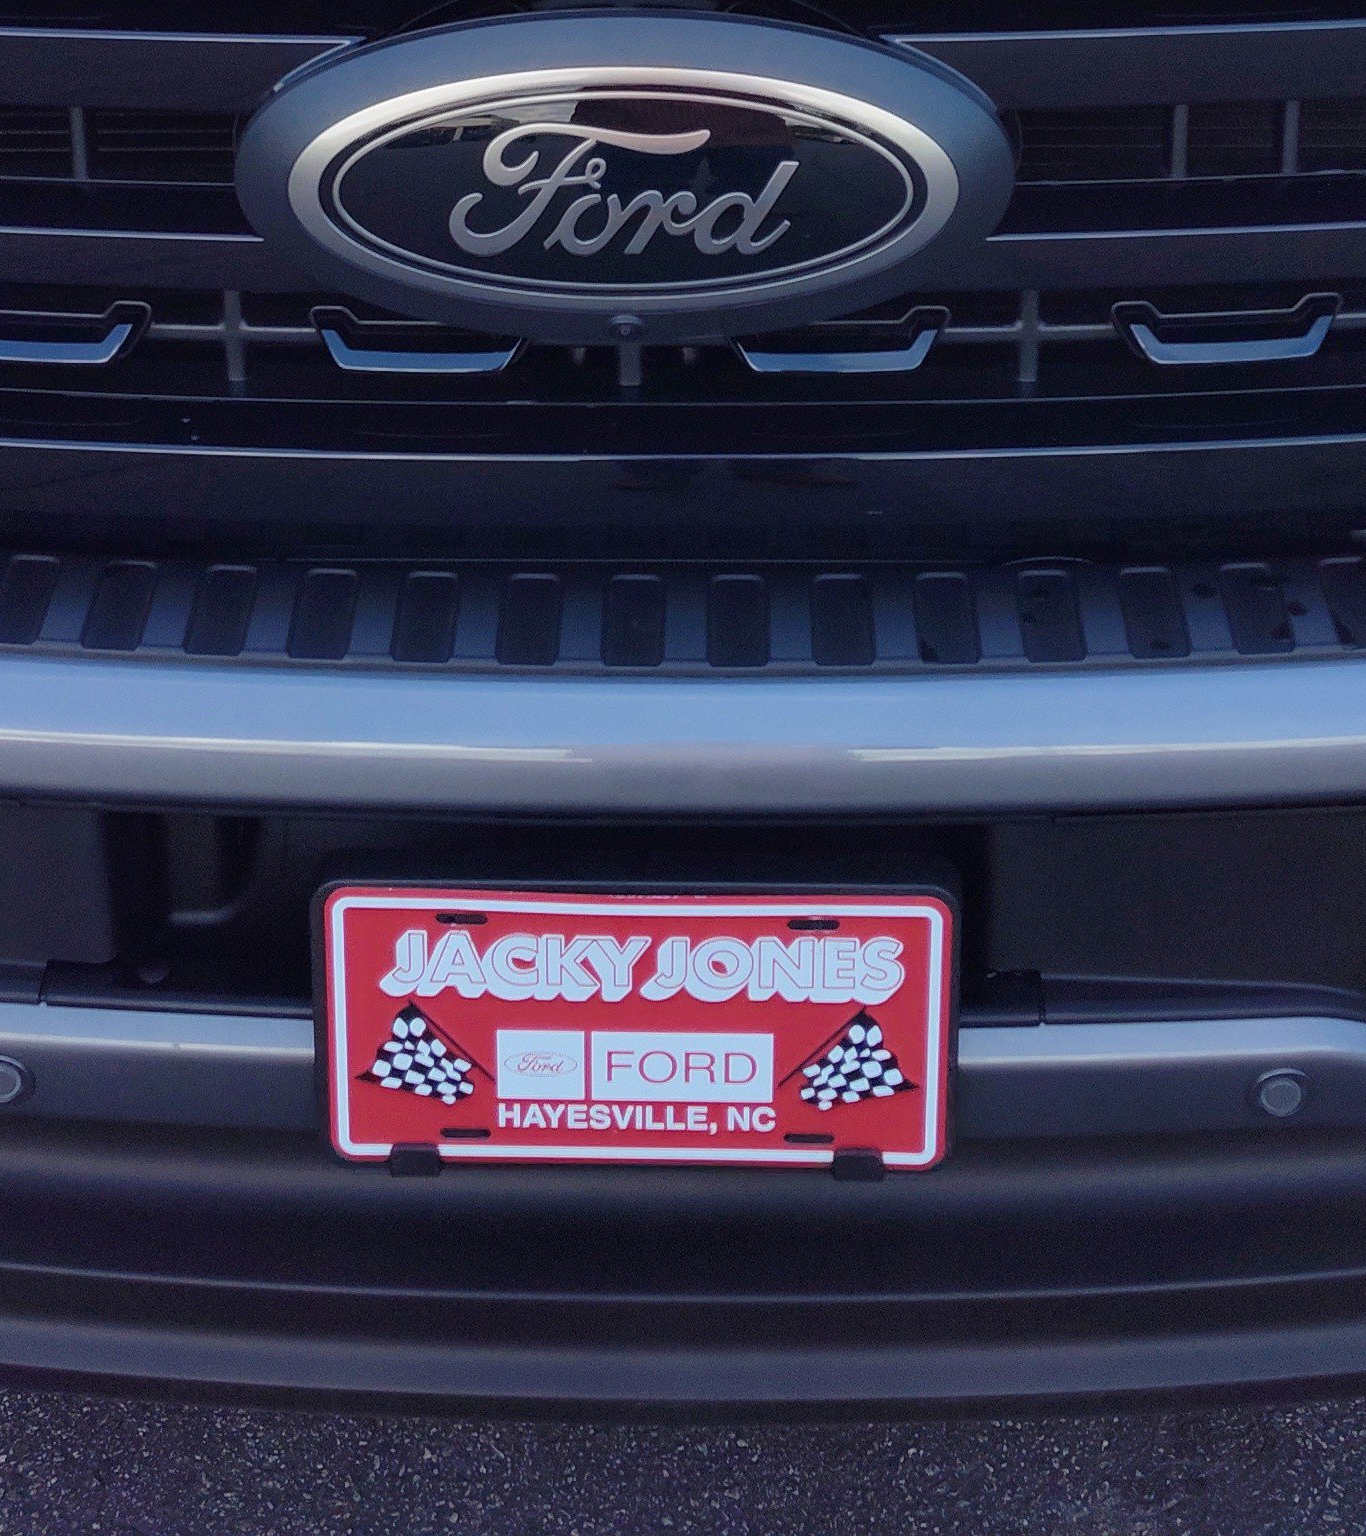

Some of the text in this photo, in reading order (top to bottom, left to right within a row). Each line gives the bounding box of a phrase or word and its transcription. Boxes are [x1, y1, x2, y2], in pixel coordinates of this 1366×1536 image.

[448, 122, 800, 256] Ford
[380, 929, 906, 1006] JACKY JONES
[516, 1052, 565, 1074] Ford
[605, 1050, 758, 1085] FORD
[497, 1102, 777, 1135] HAYESVILLE, NC
